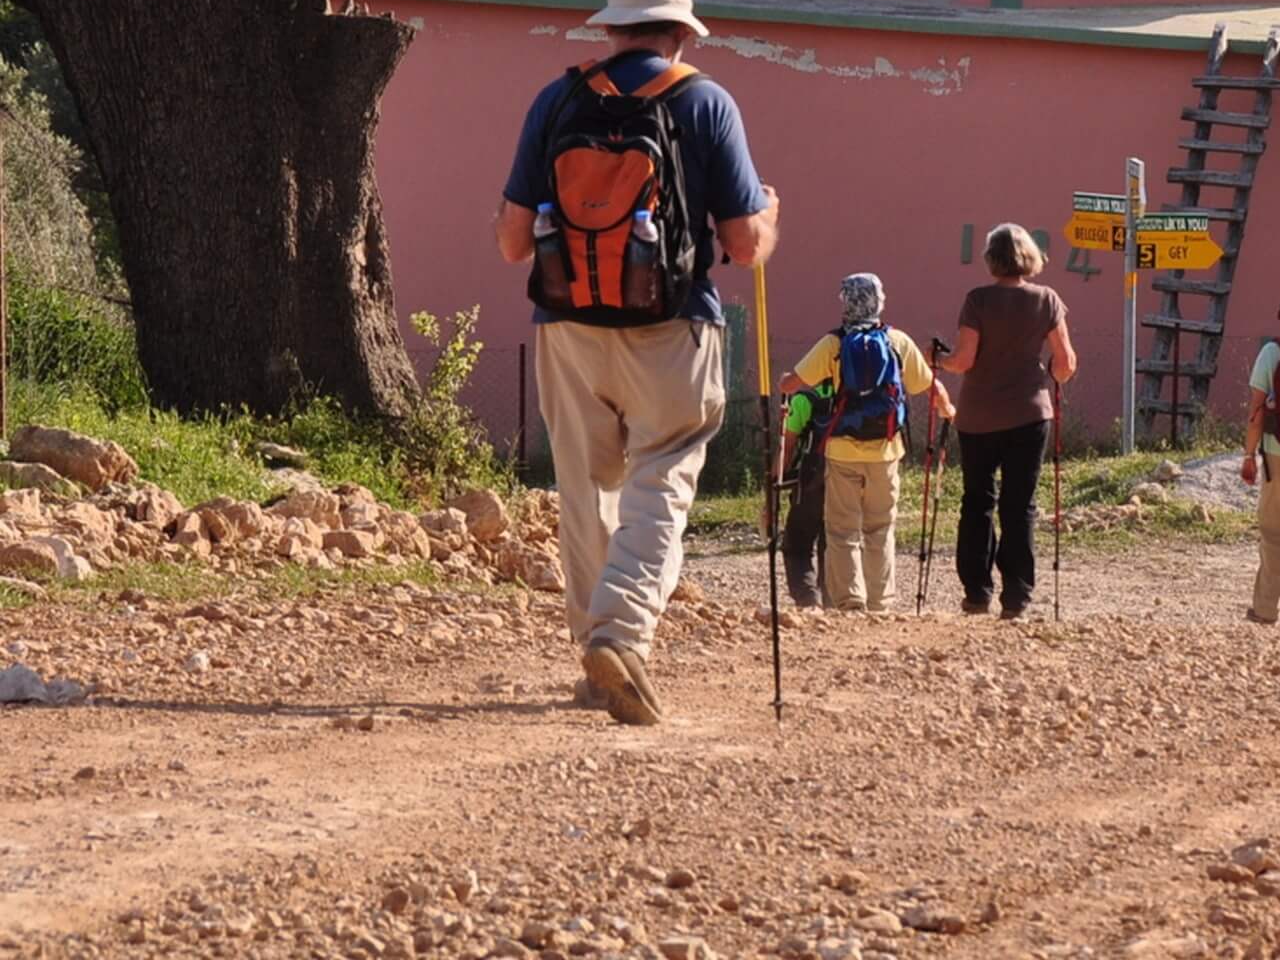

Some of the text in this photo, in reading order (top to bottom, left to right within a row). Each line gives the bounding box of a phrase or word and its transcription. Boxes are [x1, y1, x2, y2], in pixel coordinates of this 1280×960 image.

[1187, 218, 1208, 231] YOLU
[1114, 227, 1124, 244] 4
[1140, 245, 1189, 261] 5 GEY
